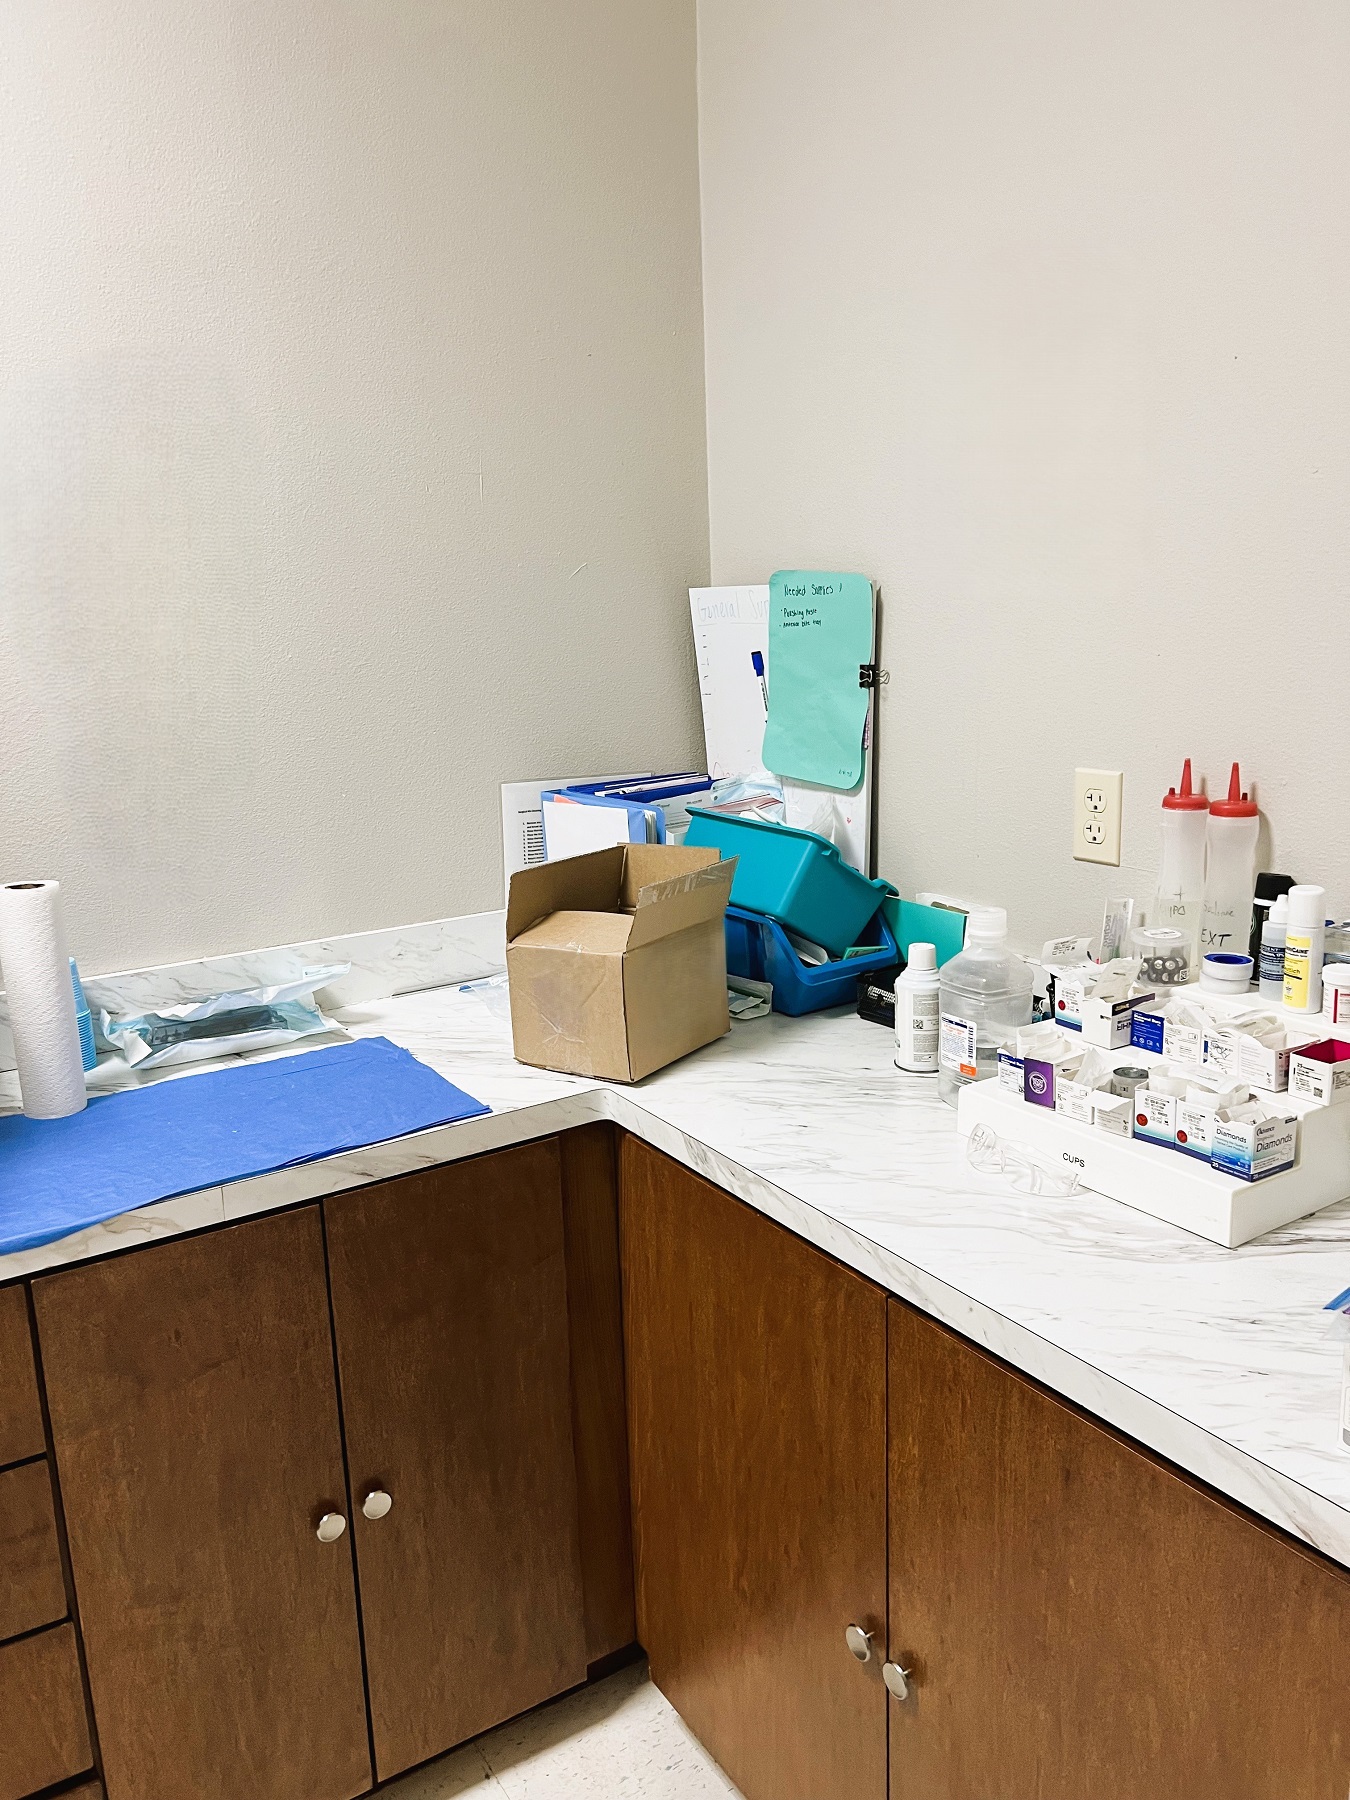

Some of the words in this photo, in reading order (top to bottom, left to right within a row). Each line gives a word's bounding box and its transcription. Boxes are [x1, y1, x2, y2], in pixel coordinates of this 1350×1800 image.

[784, 584, 806, 597] Needed
[1201, 928, 1232, 947] EXT
[1216, 1128, 1247, 1143] Diamonds
[1256, 1133, 1293, 1153] Diamonds
[1062, 1152, 1085, 1168] CUPS
